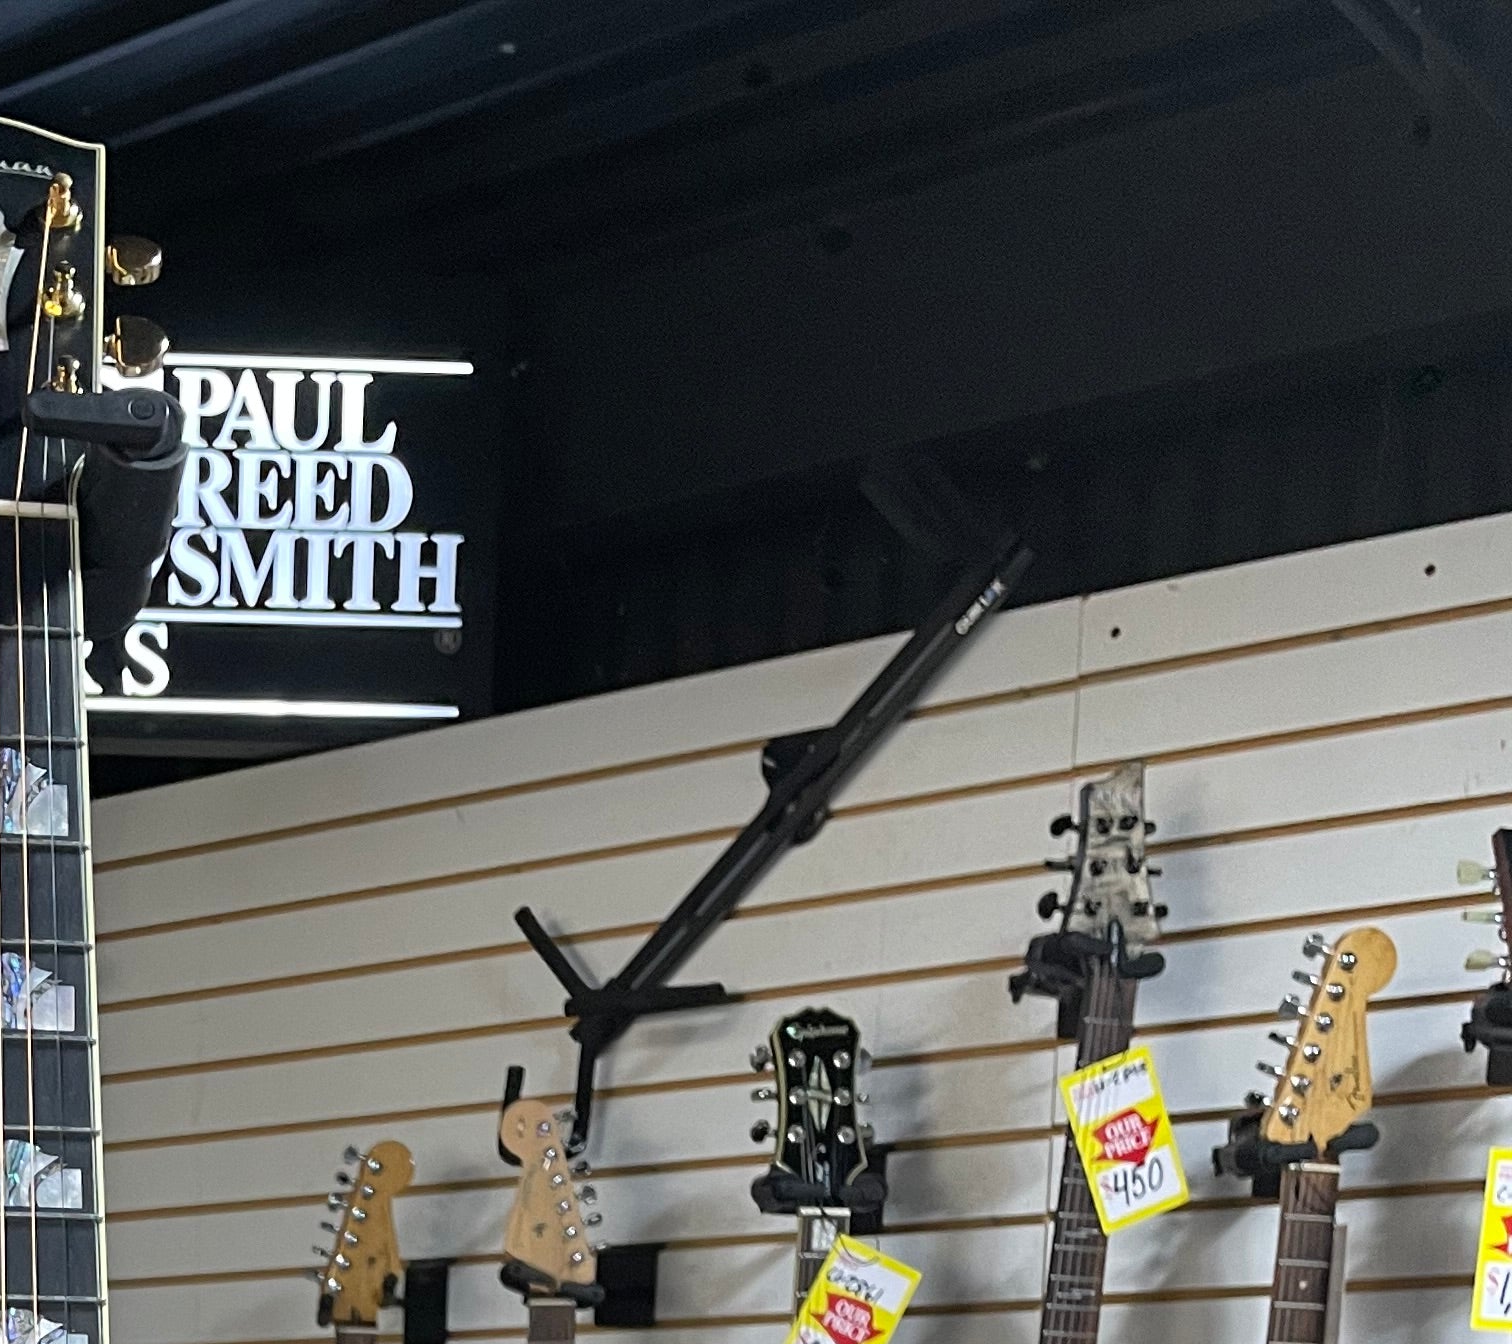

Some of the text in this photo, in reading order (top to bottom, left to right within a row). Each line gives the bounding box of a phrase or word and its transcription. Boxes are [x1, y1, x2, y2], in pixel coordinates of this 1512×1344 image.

[172, 368, 397, 454] PAUL
[172, 447, 414, 533] REED
[168, 526, 465, 613] SMITH
[1103, 1125, 1153, 1160] PRICE
[1105, 1112, 1144, 1142] OUR
